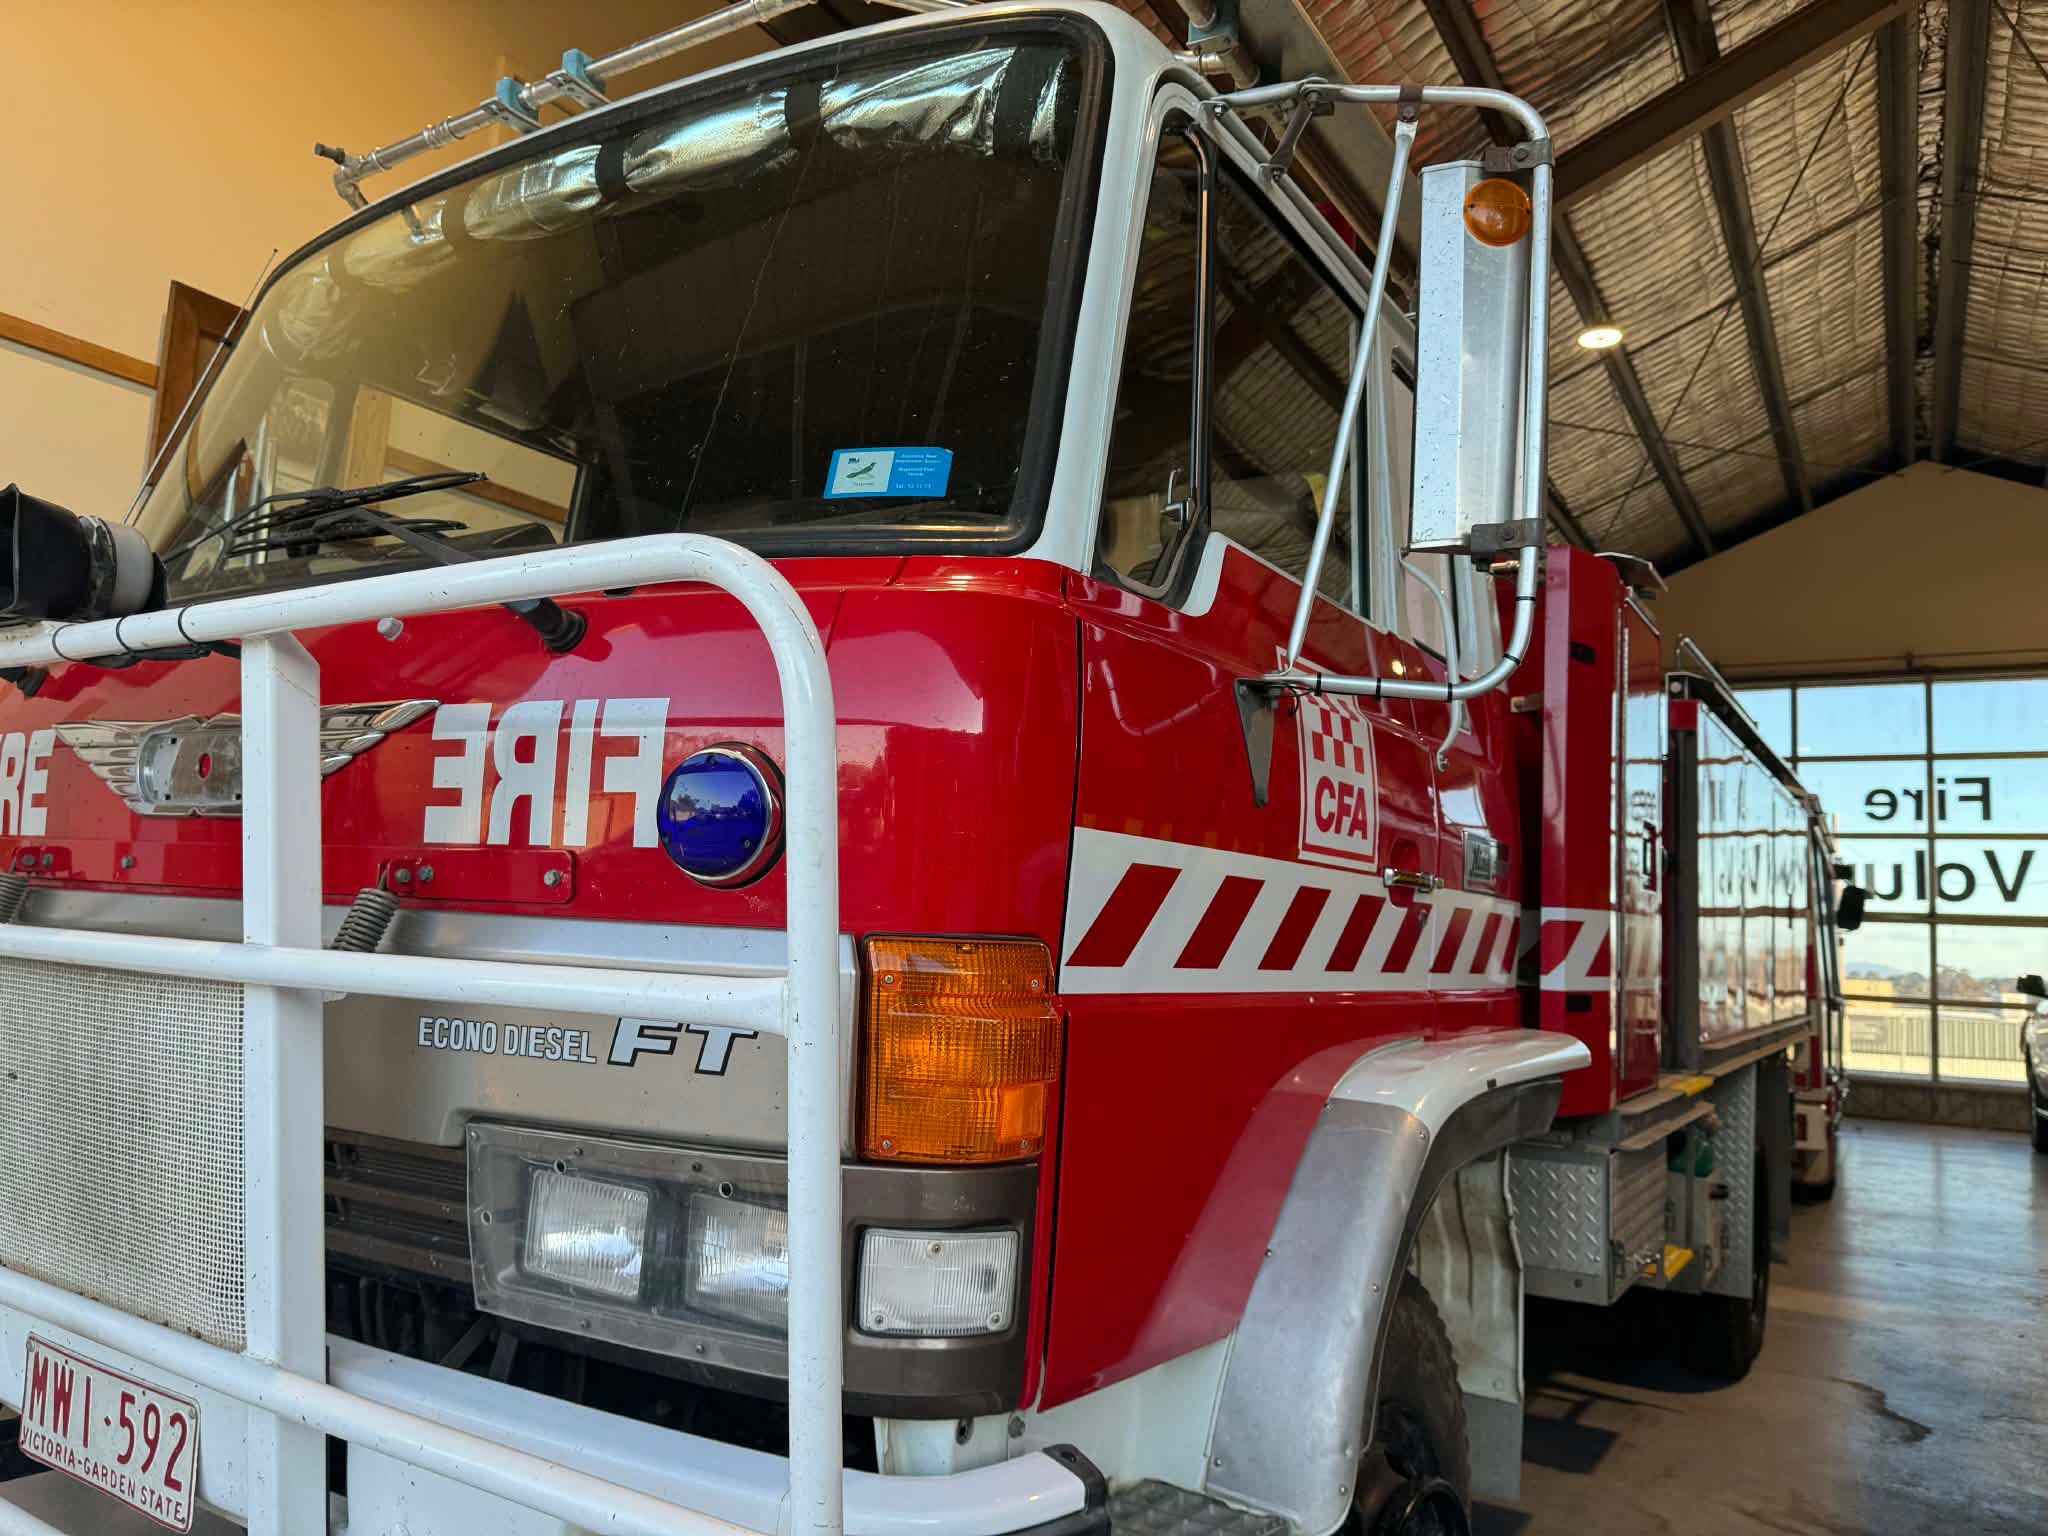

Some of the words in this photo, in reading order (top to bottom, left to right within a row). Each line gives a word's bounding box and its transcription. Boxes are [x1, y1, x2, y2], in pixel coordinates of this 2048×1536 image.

[0, 729, 57, 836] RE
[1314, 776, 1368, 840] CFA
[417, 1016, 497, 1055] ECONO
[502, 1023, 598, 1065] DIESEL
[606, 1016, 760, 1076] FT
[140, 1486, 186, 1523] STATE
